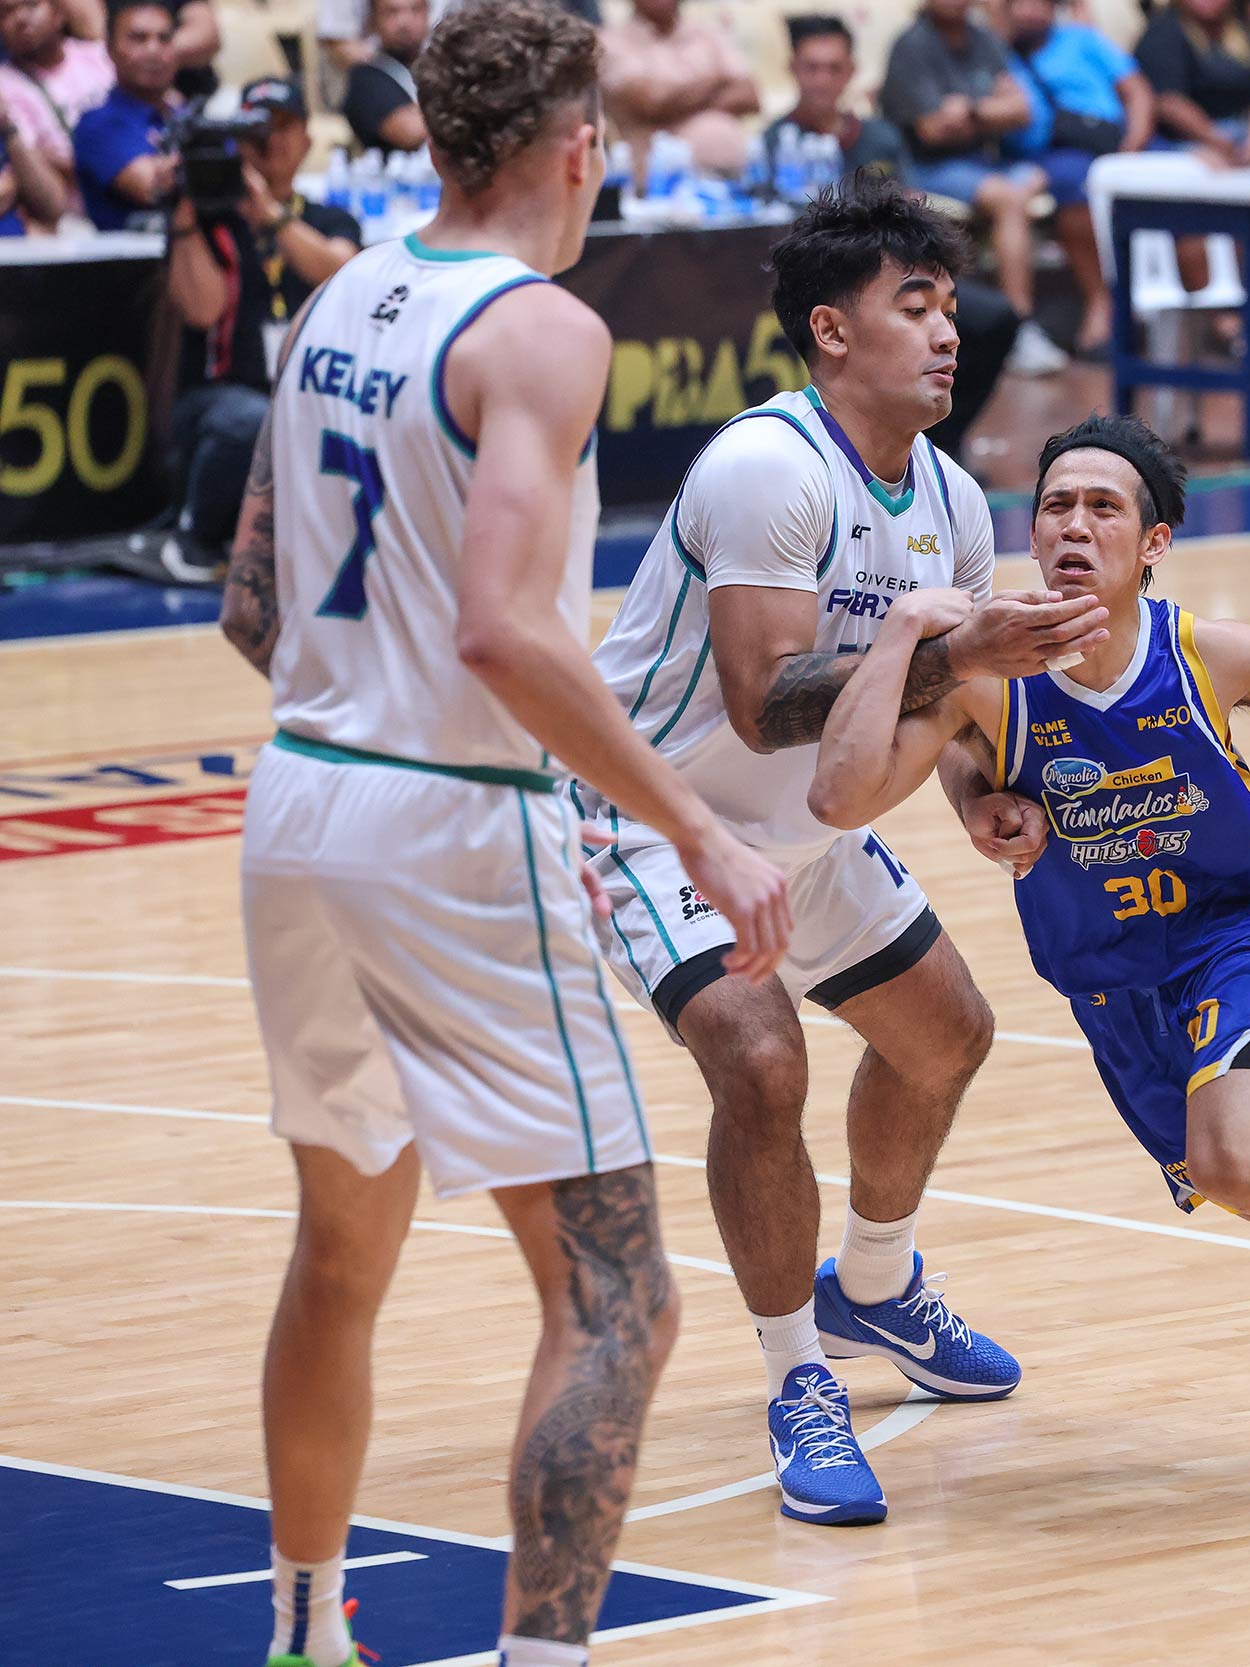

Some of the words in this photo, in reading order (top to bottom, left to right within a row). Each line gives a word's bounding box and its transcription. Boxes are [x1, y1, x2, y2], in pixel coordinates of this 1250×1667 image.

[606, 312, 811, 432] PBA5
[0, 354, 147, 497] 50
[314, 427, 385, 620] 7
[1034, 732, 1072, 747] VLLE
[1112, 772, 1162, 787] Chicken
[1056, 791, 1173, 831] Timplados
[1104, 868, 1187, 920] 30
